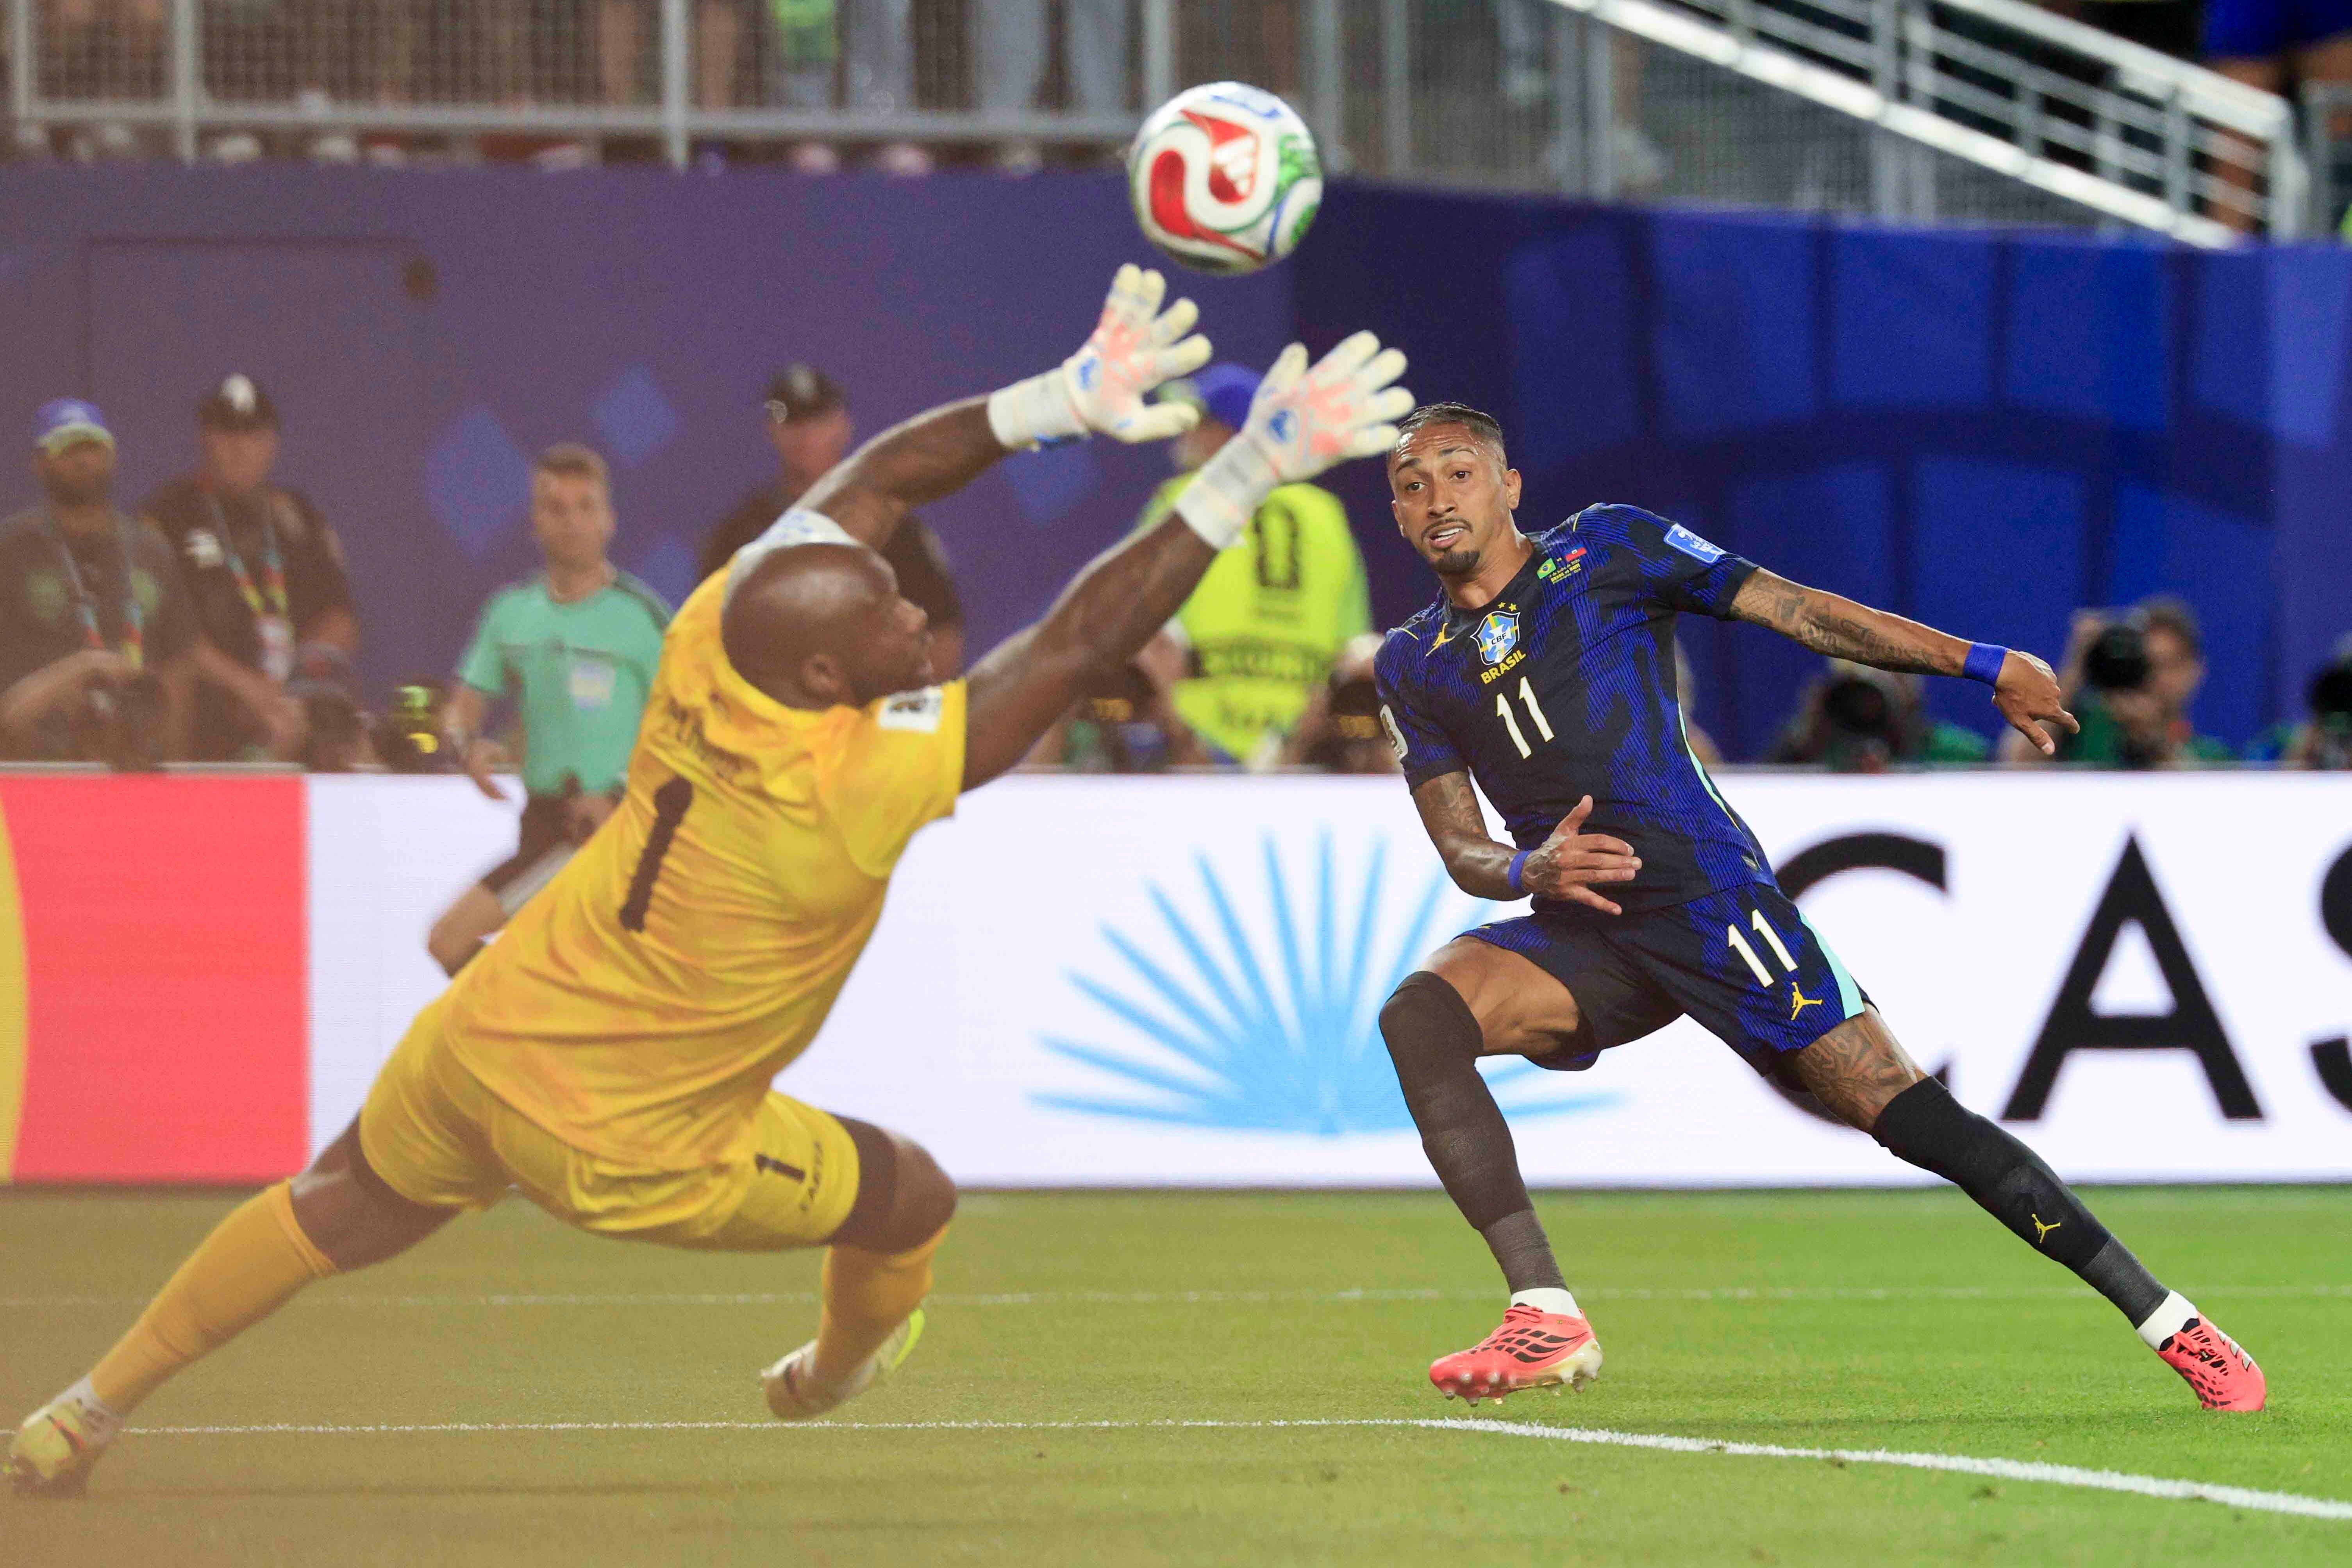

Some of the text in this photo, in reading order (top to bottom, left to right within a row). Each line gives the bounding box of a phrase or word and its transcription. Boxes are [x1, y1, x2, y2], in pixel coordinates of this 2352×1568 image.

[1480, 650, 1526, 684] BRASIL
[1491, 633, 1507, 645] CBF
[1497, 676, 1554, 759] 11
[618, 774, 693, 933] 1
[1728, 909, 1798, 988] 11
[754, 1153, 806, 1184] 1
